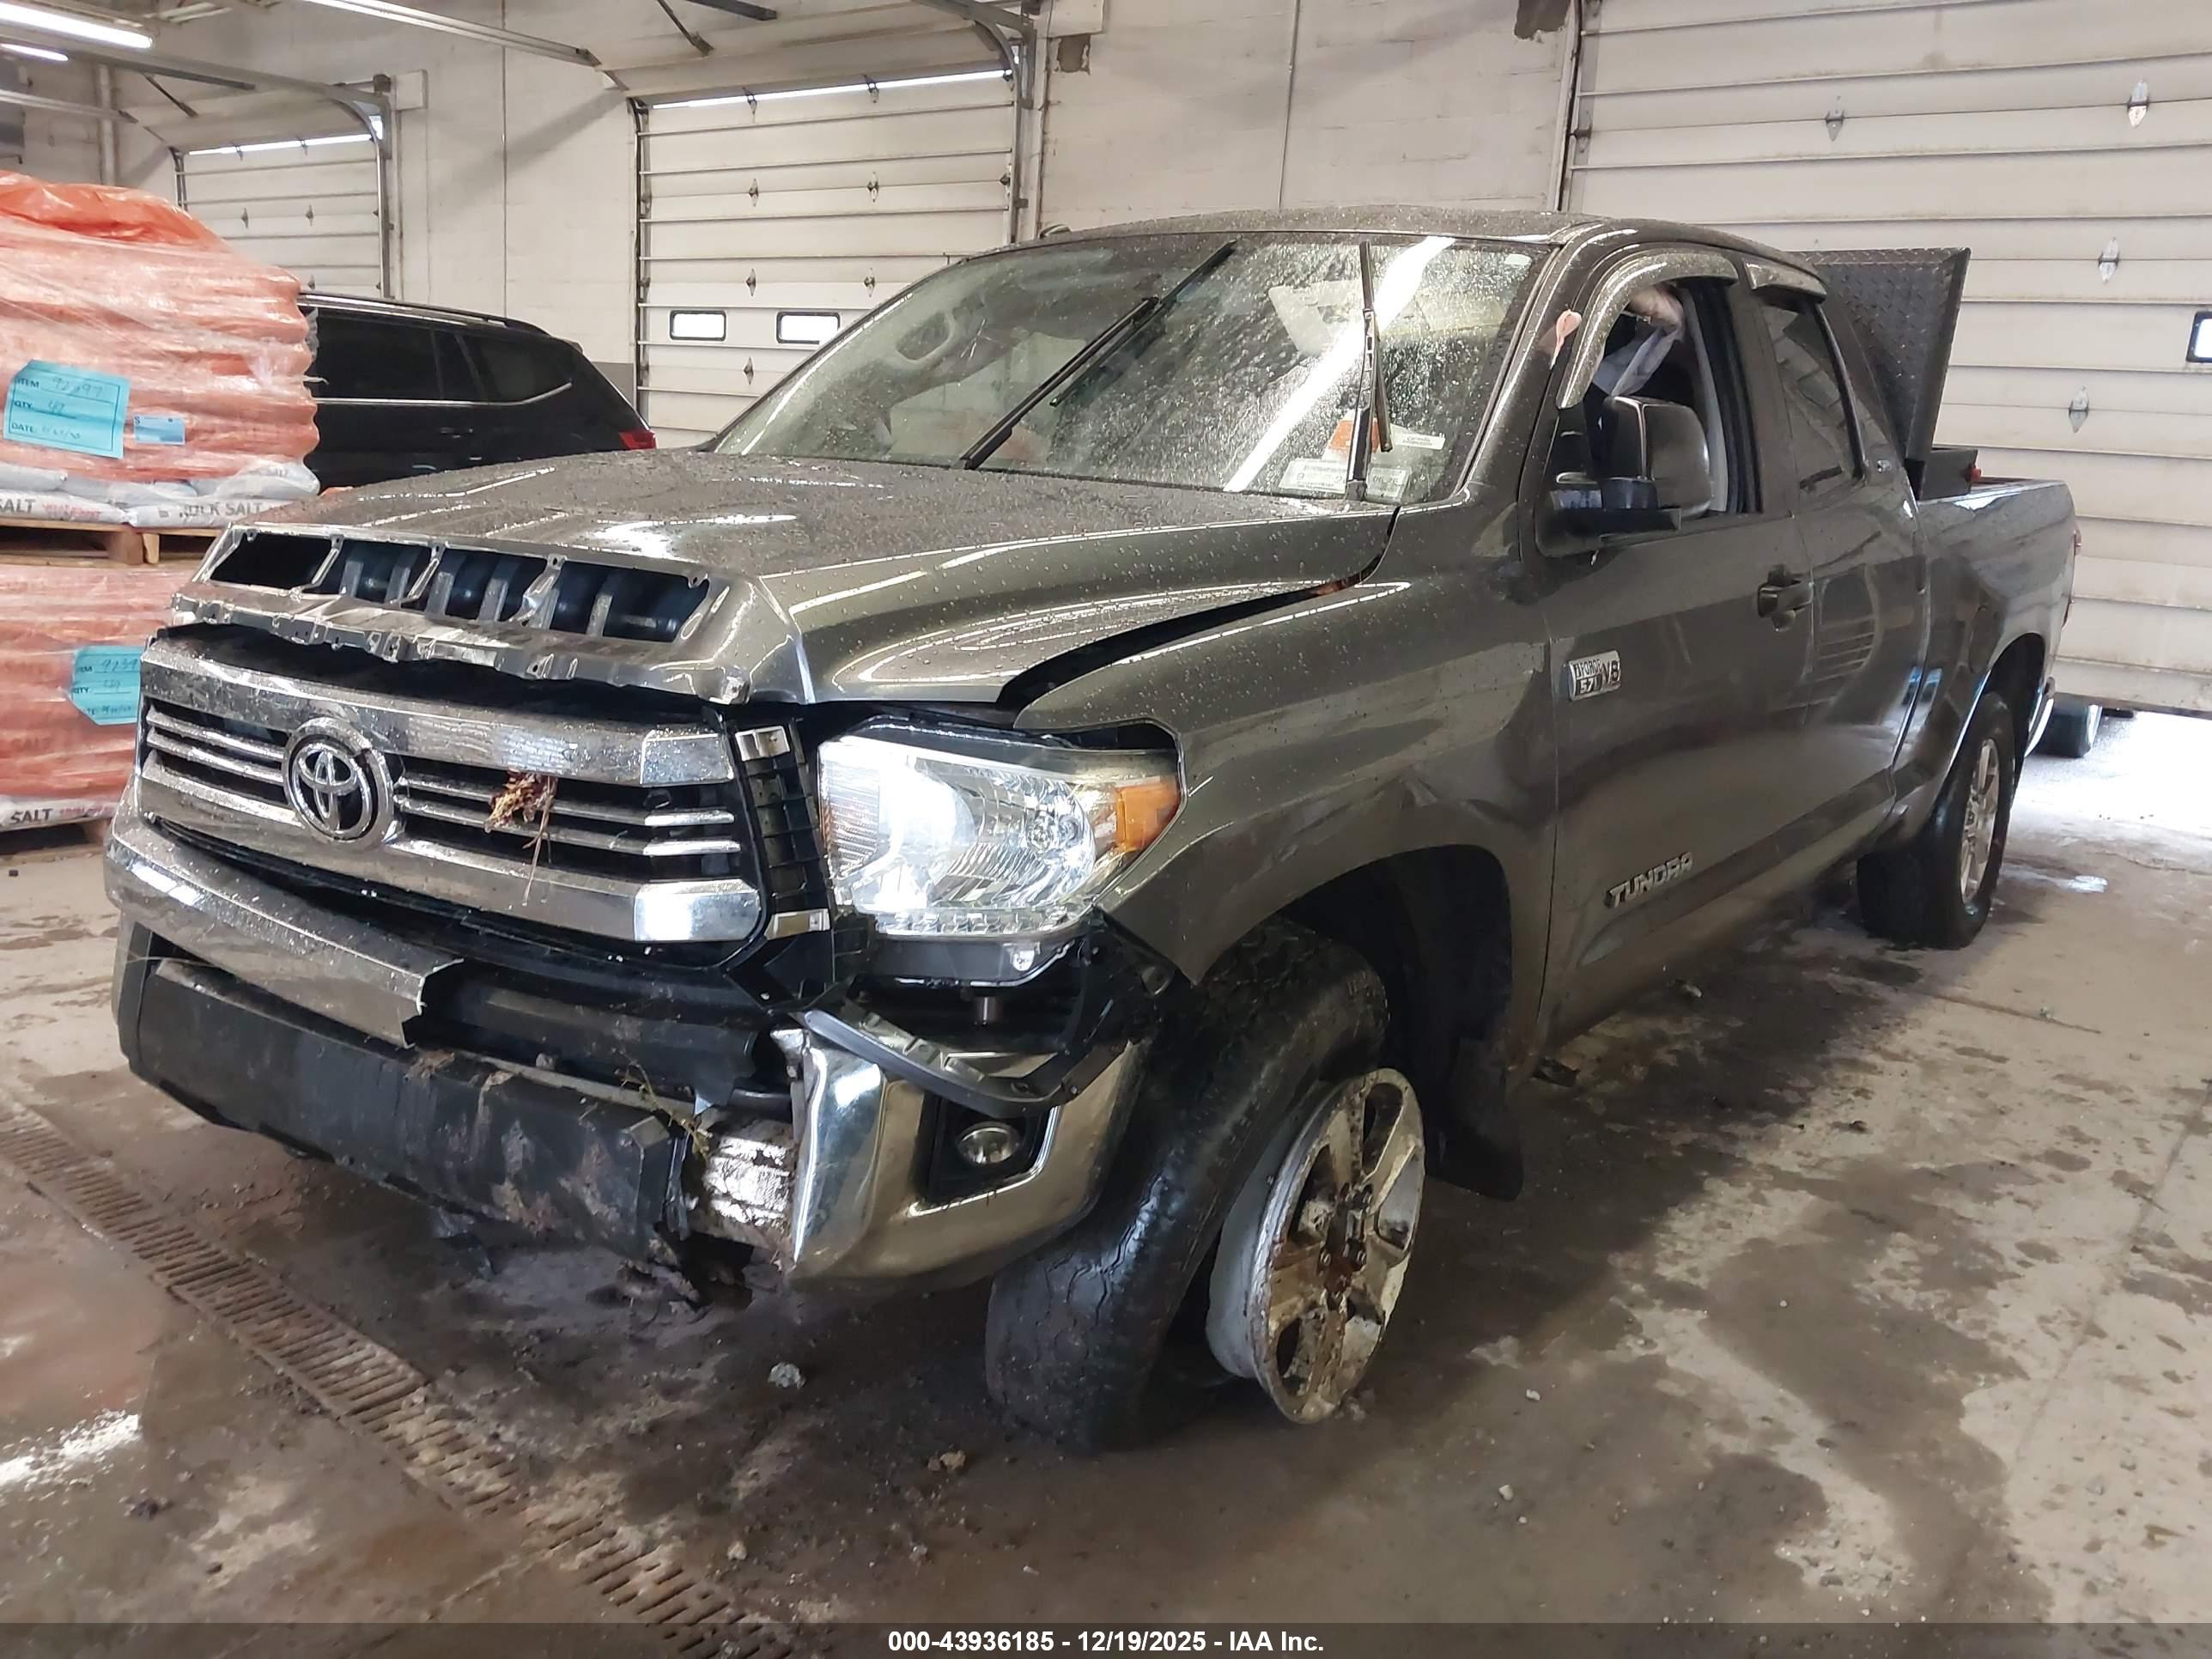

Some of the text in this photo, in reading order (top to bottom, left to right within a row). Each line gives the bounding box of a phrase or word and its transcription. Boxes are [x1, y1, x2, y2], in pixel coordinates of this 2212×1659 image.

[15, 378, 40, 388] ITEM
[225, 501, 262, 517] SALT
[10, 808, 52, 824] SALT
[1609, 851, 1692, 908] TUNDRA
